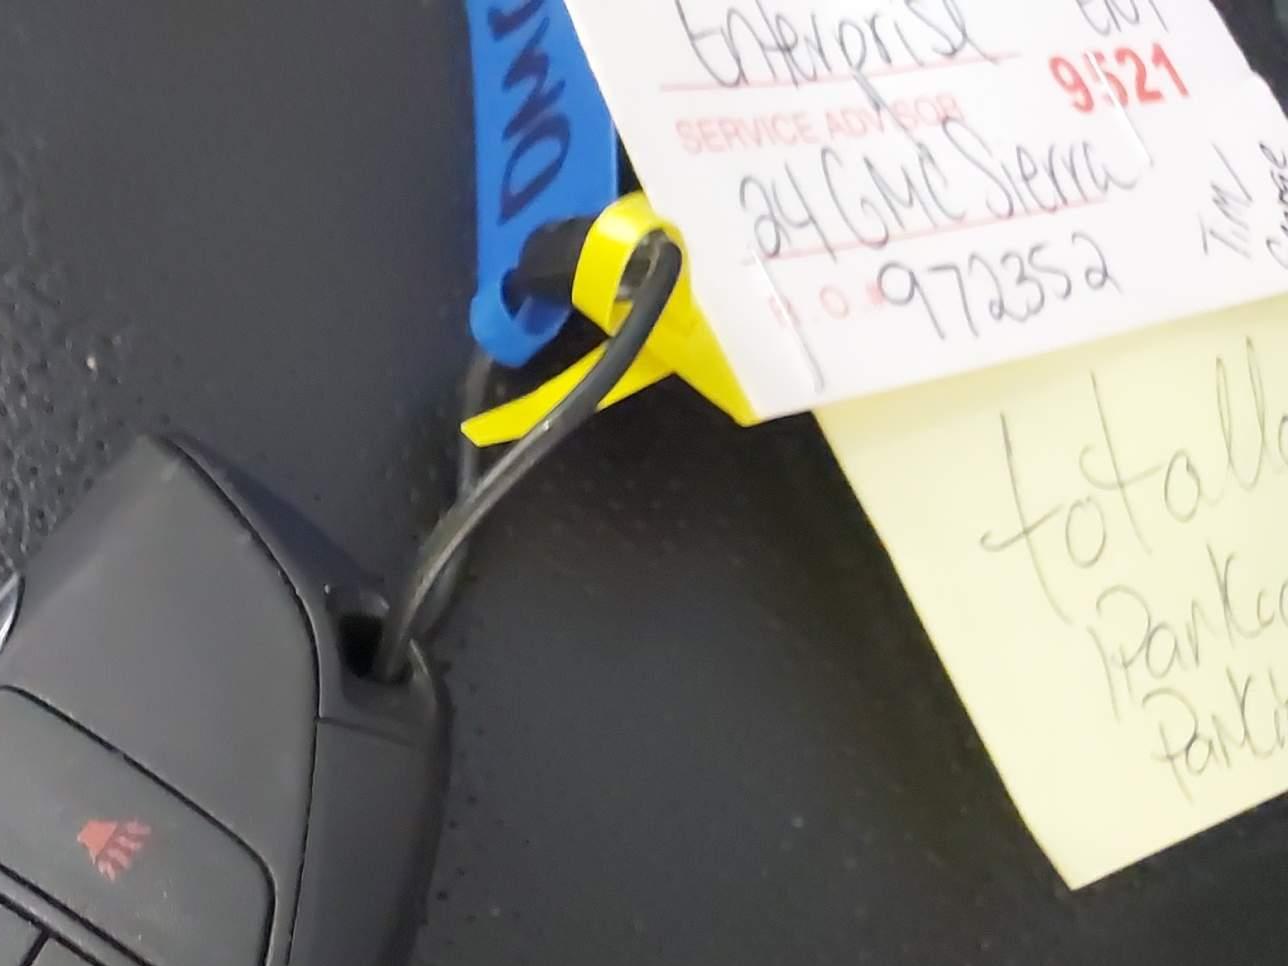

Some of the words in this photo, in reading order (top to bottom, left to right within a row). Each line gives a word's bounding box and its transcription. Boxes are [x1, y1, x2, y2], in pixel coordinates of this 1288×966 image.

[675, 111, 821, 155] SERVICE
[824, 93, 966, 140] ADVSOR
[739, 161, 837, 263] 24
[821, 141, 966, 249] GMC
[941, 115, 1137, 219] Sierra
[877, 231, 1123, 340] 972352
